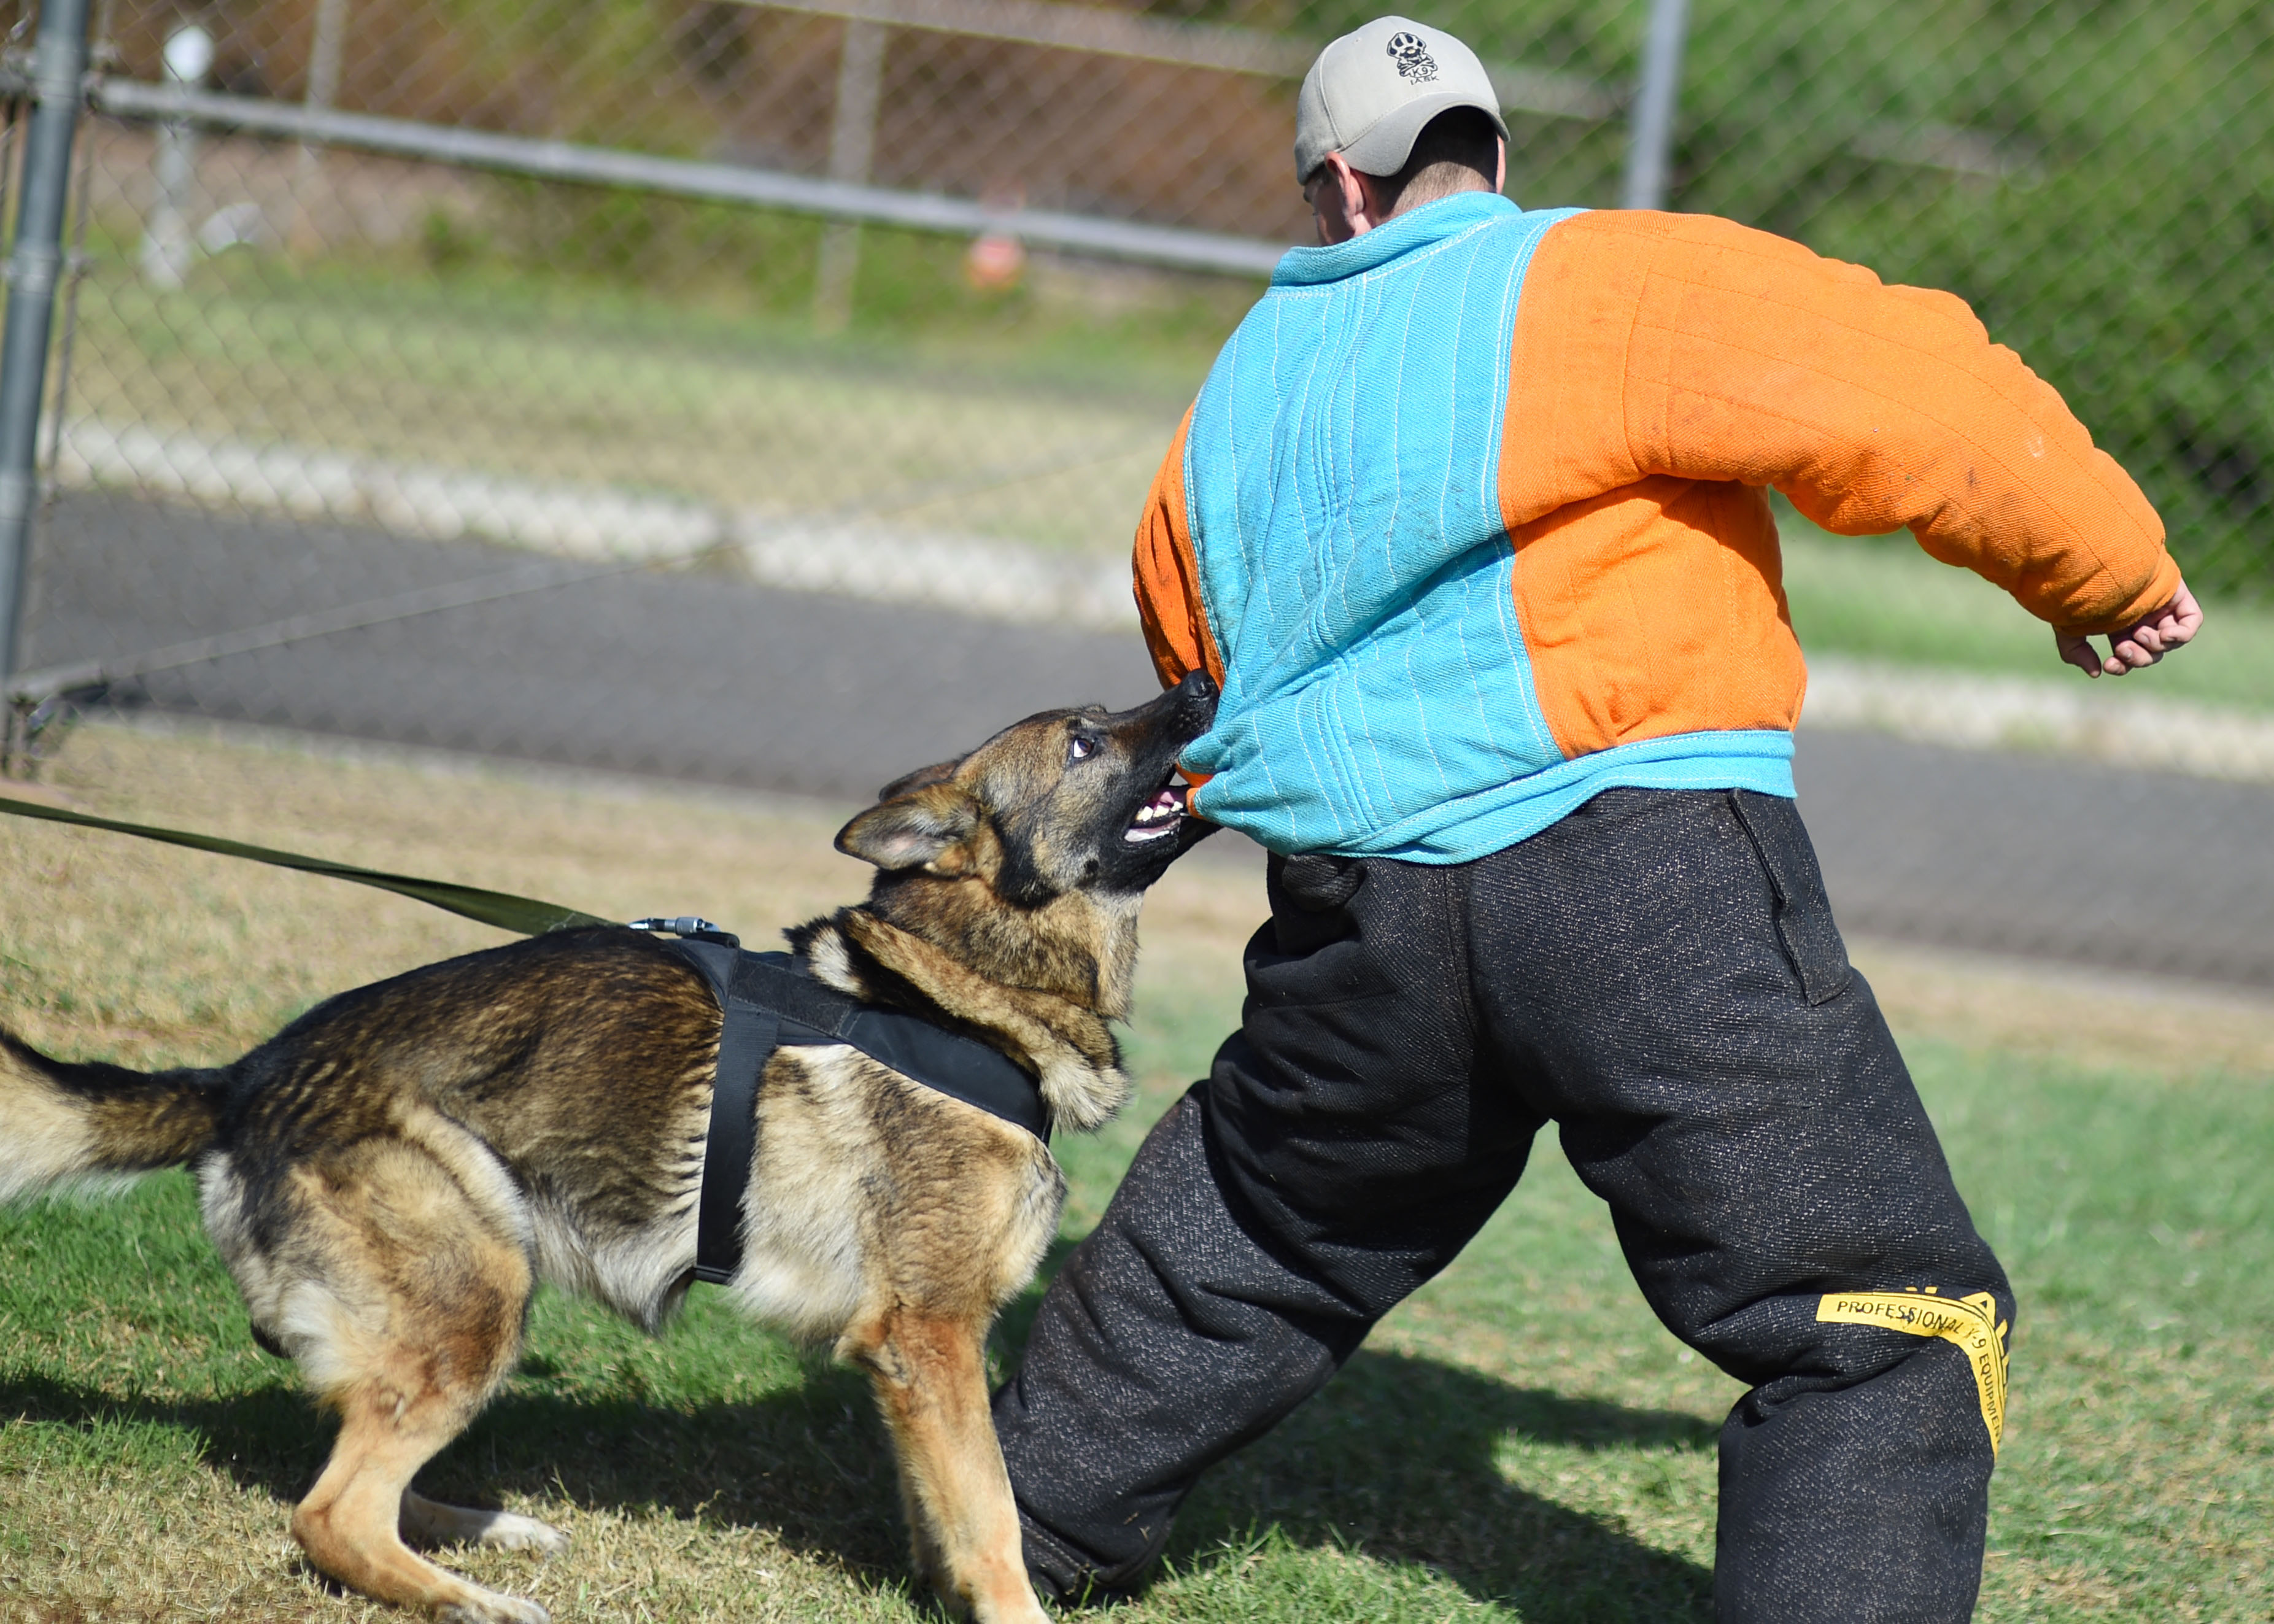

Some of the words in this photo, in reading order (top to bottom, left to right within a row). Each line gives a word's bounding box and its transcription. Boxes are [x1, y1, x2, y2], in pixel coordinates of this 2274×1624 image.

[1412, 67, 1428, 77] K9
[1836, 1301, 1964, 1334] PROFESSIONAL
[1979, 1353, 2001, 1443] EQUIPMEN
